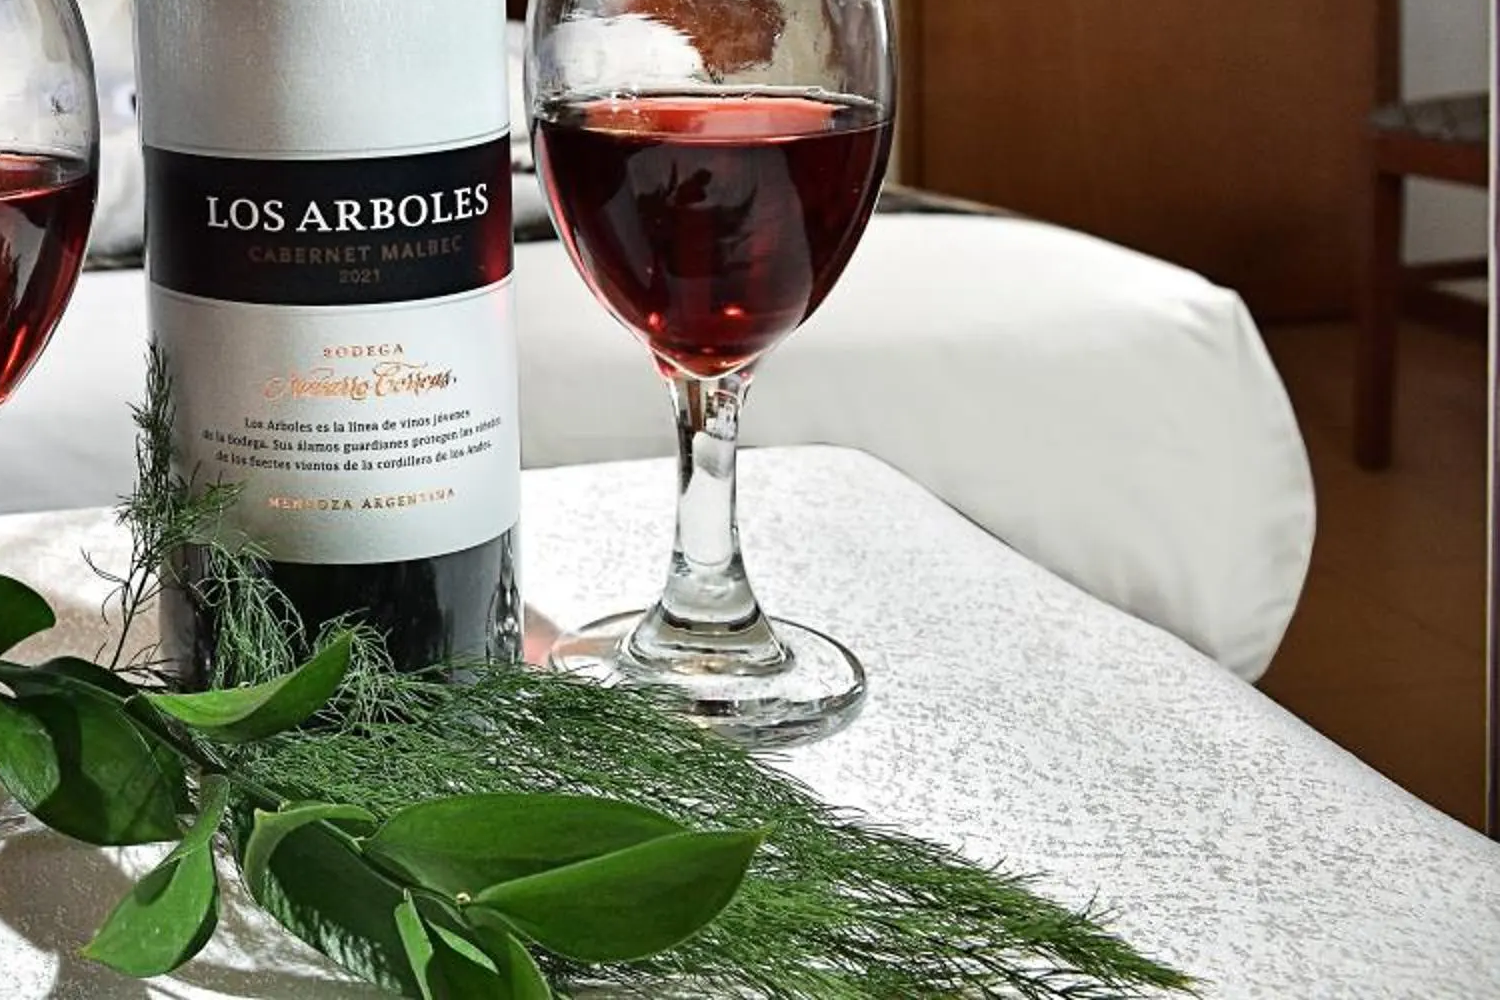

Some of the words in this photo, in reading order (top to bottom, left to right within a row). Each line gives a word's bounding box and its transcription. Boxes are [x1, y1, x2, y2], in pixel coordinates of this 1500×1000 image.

[206, 196, 285, 231] LOS
[296, 183, 489, 233] ARBOLES
[248, 245, 371, 264] CABERNET
[381, 235, 462, 262] MALBEC
[339, 269, 380, 283] 2021
[324, 343, 404, 358] BODEGA
[244, 416, 263, 429] Los
[315, 424, 330, 433] es
[333, 421, 345, 433] la
[382, 419, 397, 431] de
[399, 416, 431, 429] vinos
[273, 439, 293, 451] Sus
[343, 438, 409, 455] guardianes
[343, 459, 359, 471] de
[361, 459, 373, 471] la
[435, 450, 447, 463] de
